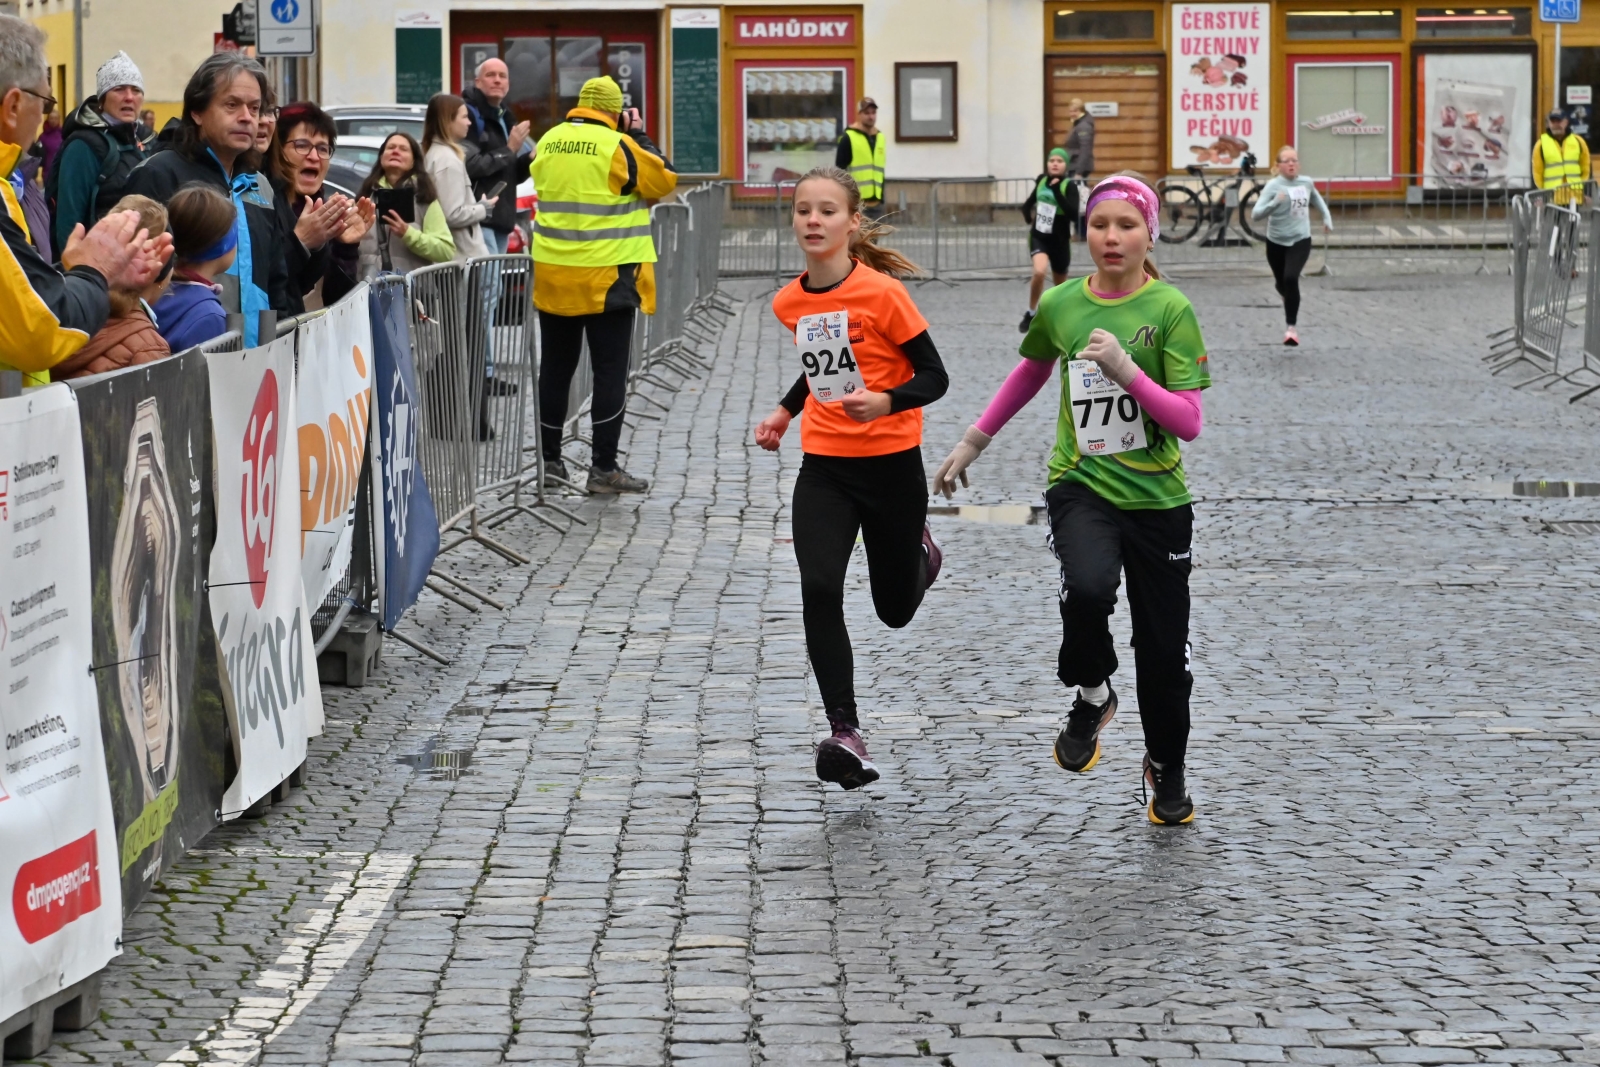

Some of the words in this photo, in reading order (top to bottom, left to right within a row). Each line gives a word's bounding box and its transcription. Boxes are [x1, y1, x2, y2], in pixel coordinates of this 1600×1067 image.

[740, 18, 848, 38] LAHŮDKY
[1181, 6, 1260, 30] ČERSTVÉ
[1180, 36, 1260, 56] UZENINY
[1180, 88, 1259, 111] ČERSTVÉ
[1187, 113, 1253, 137] PEČIVO
[544, 138, 598, 156] POŘADATEL
[1290, 198, 1308, 208] 752
[1037, 213, 1053, 226] 798
[801, 347, 857, 378] 924
[1072, 393, 1139, 429] 770
[1089, 443, 1106, 451] CUP
[24, 714, 67, 742] marketing
